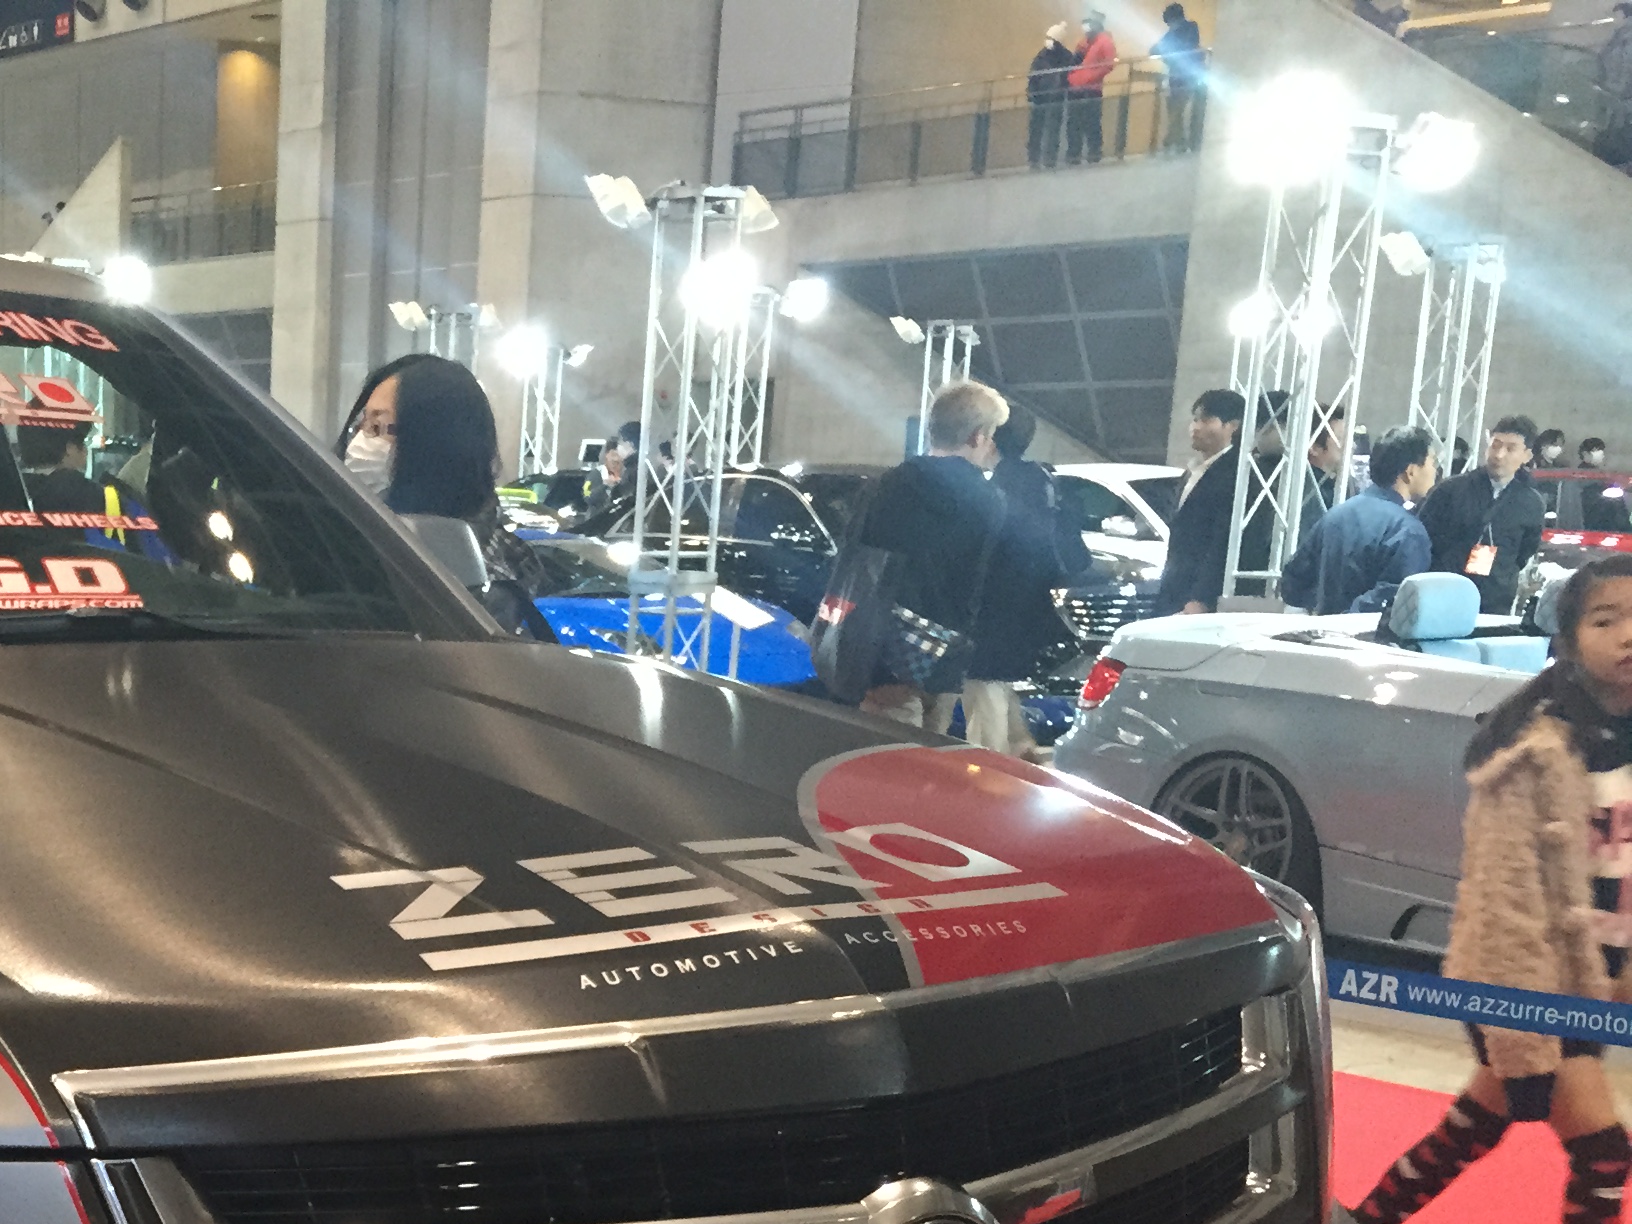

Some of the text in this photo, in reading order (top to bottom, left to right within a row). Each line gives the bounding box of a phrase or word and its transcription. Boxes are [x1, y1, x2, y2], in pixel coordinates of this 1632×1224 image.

[42, 511, 160, 531] WHEELS
[329, 822, 1023, 941] ZERO
[579, 920, 1028, 990] AUTOMOTIVE ACCESSORIES
[1339, 967, 1399, 1004] AZR
